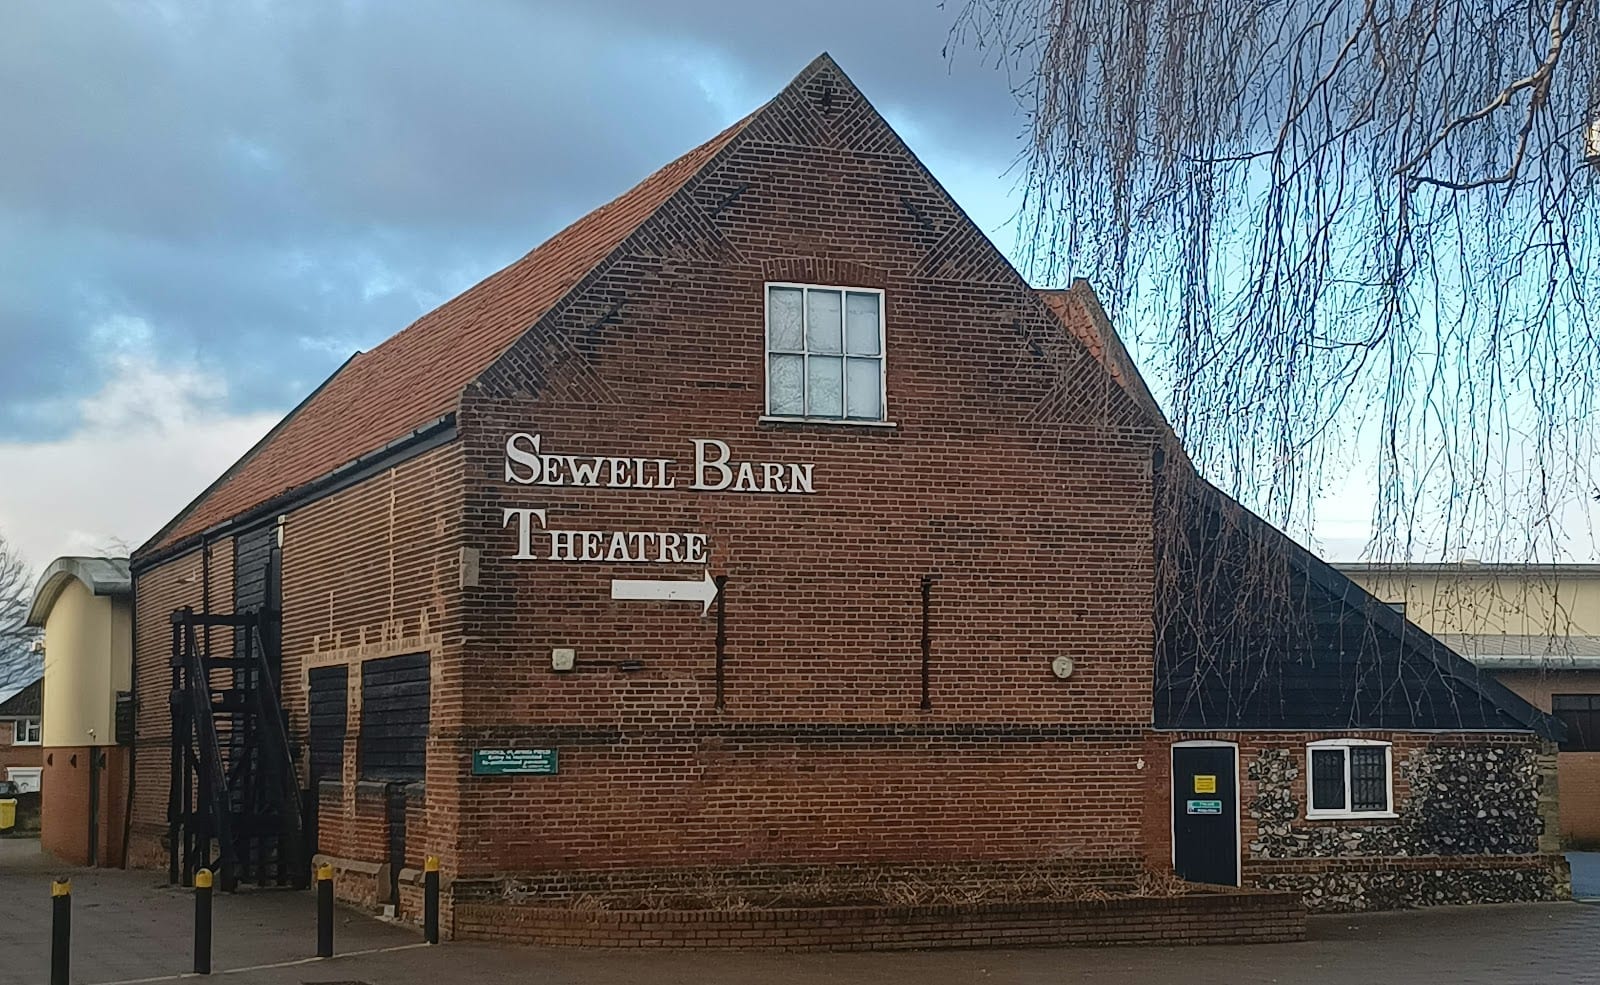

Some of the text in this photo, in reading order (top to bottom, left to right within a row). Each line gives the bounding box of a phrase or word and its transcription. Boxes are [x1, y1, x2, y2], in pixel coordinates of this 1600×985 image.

[505, 432, 816, 493] SEWELL BARN
[503, 508, 708, 563] THEATRE
